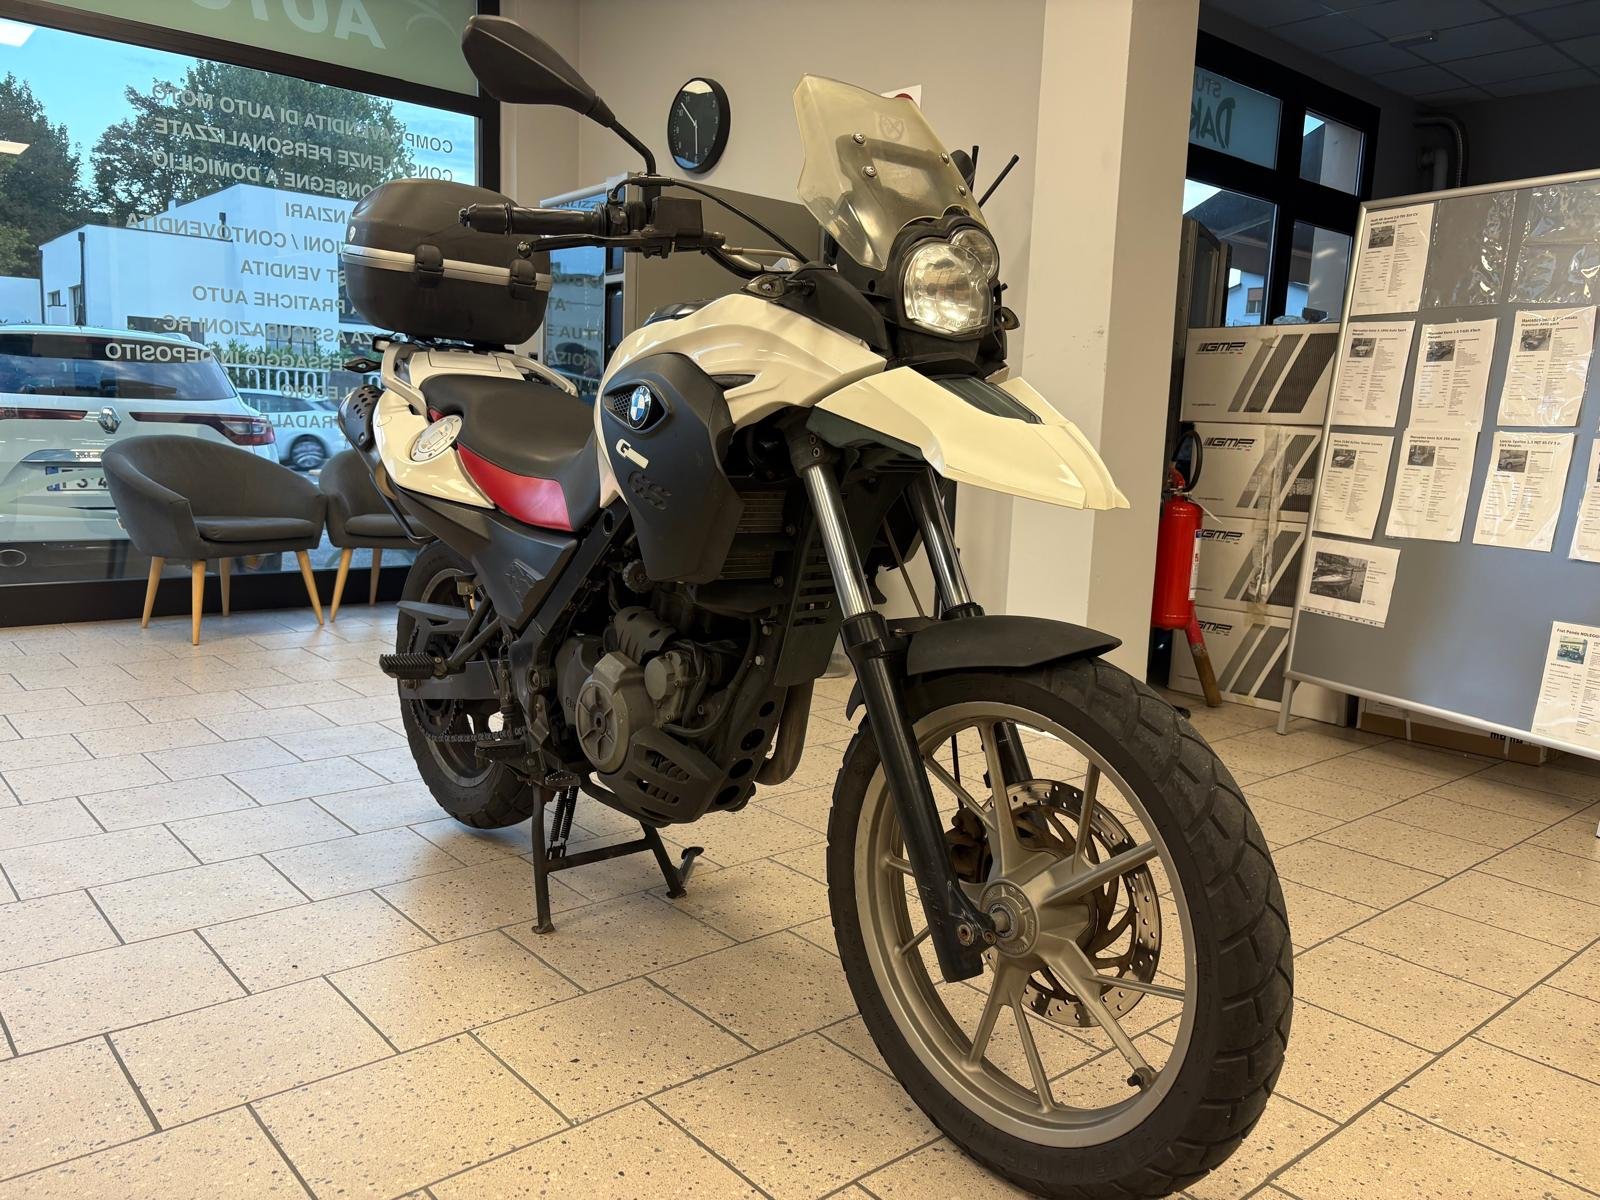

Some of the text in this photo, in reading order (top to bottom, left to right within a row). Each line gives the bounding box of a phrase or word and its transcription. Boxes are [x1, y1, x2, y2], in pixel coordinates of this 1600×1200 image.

[1205, 342, 1246, 352] GMP
[1212, 437, 1256, 448] GMP
[1201, 528, 1243, 540] GMP
